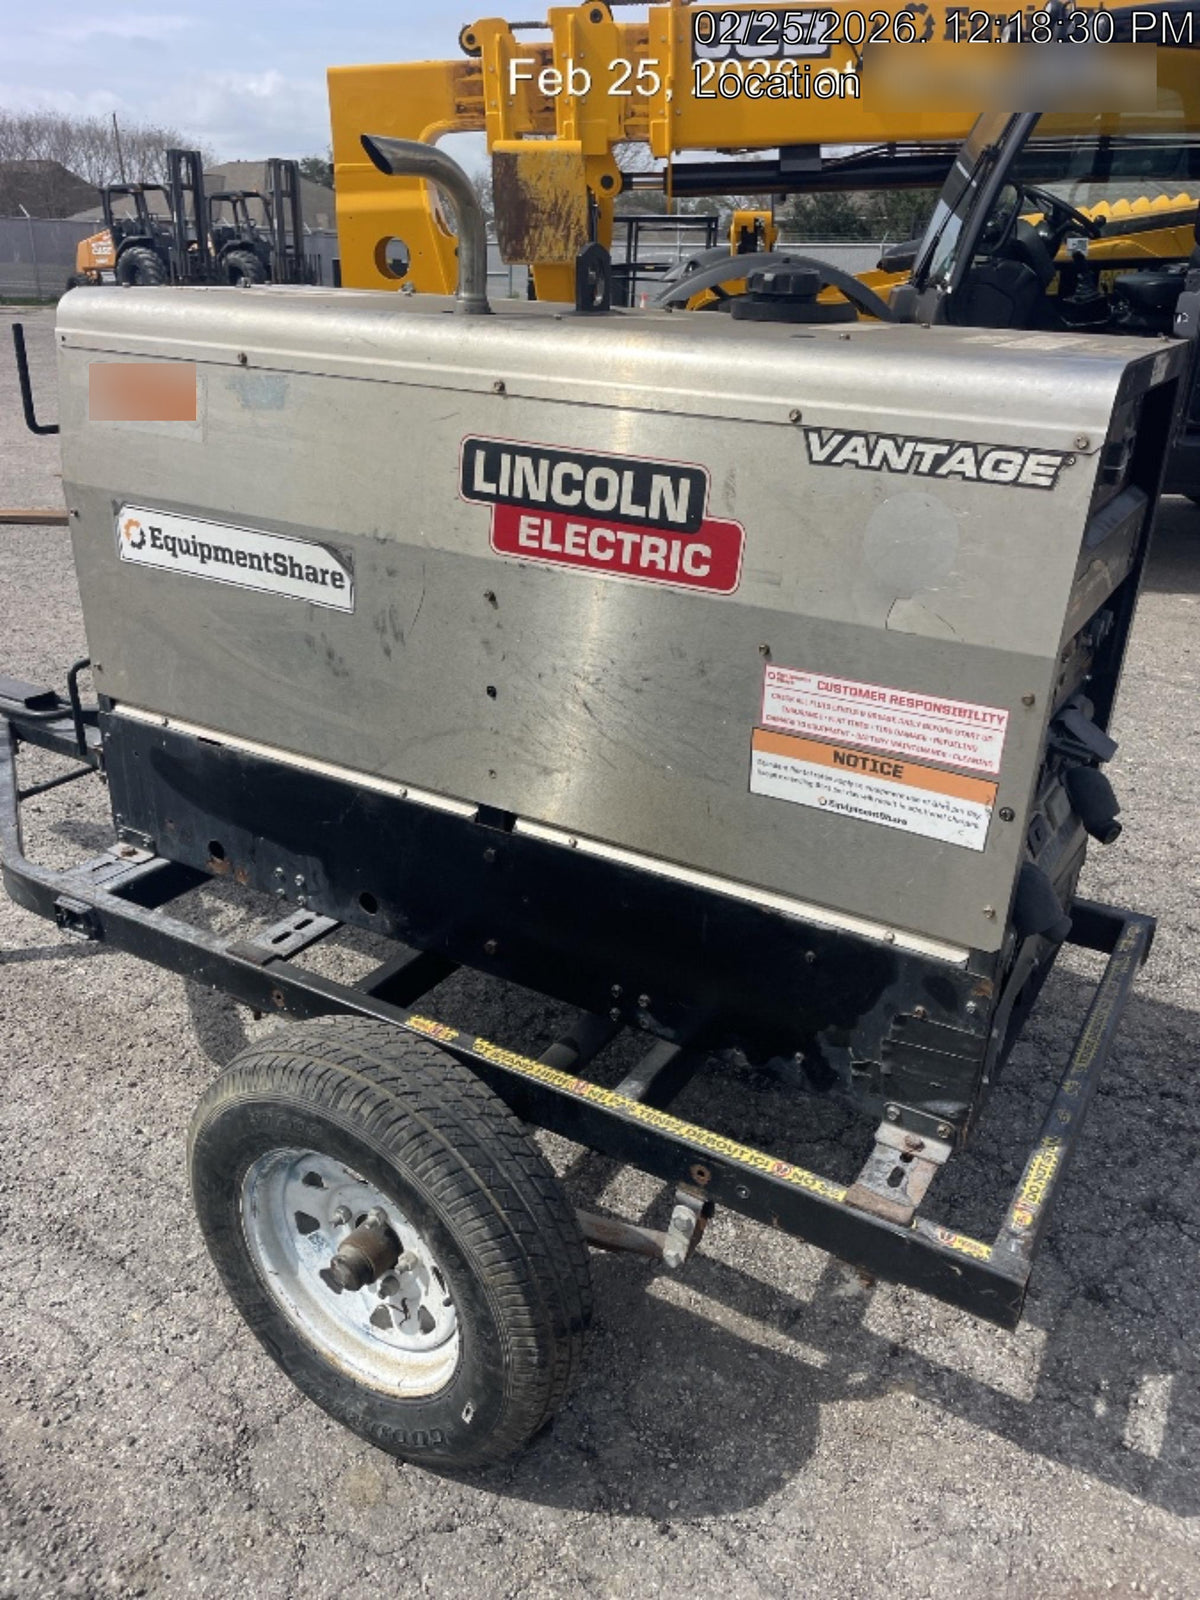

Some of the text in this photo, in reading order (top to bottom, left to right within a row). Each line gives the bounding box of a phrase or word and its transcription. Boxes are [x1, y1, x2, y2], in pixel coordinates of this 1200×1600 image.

[472, 449, 692, 526] LINCOLN
[807, 430, 1067, 487] VANTAGE
[148, 525, 346, 590] EquipmentShare
[518, 515, 713, 578] ELECTRIC
[817, 680, 887, 703] CUSTOMER
[889, 694, 1006, 726] RESPONSIBILITY
[832, 750, 904, 780] NOTICE
